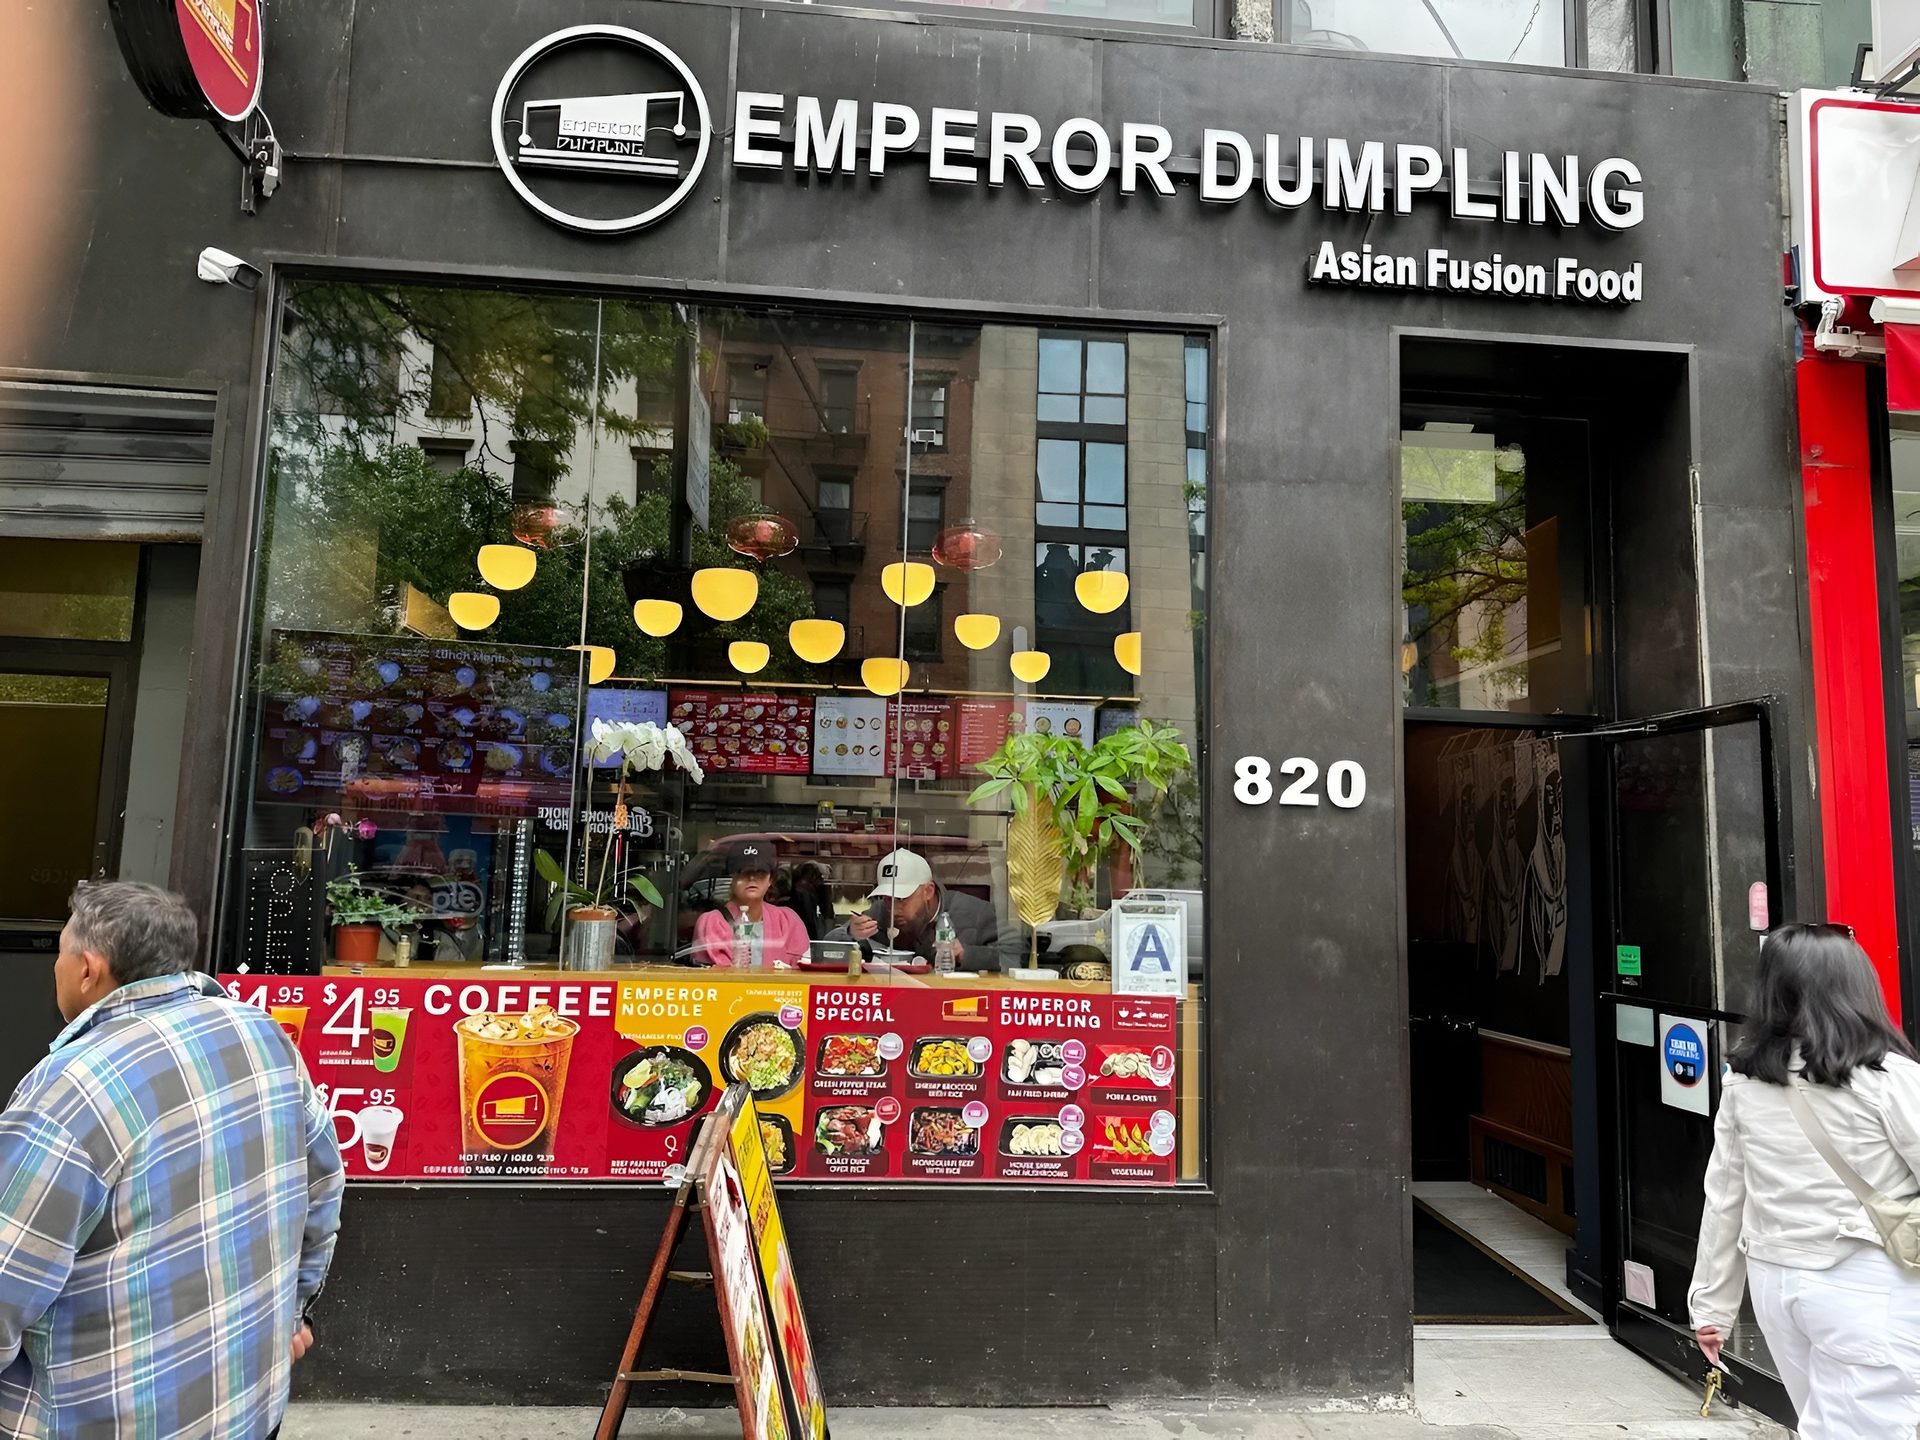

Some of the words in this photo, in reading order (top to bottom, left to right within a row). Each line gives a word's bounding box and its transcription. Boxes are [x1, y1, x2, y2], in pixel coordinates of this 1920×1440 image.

[556, 136, 644, 156] DUMPLING
[733, 91, 1176, 197] EMPEROR
[1200, 128, 1645, 230] DUMPLING
[1312, 240, 1418, 287] Asian
[1426, 247, 1547, 296] Fusion
[1556, 256, 1643, 303] Food
[1233, 755, 1367, 809] 820
[1130, 924, 1172, 972] A
[424, 985, 612, 1016] COFFEE
[623, 988, 718, 1001] EMPEROR
[816, 992, 882, 1006] HOUSE
[622, 1004, 702, 1017] NOODLE
[815, 1007, 895, 1022] SPECIAL
[1001, 997, 1092, 1013] EMPEROR
[322, 983, 400, 1048] $4.95
[1000, 1013, 1101, 1029] DUMPLING
